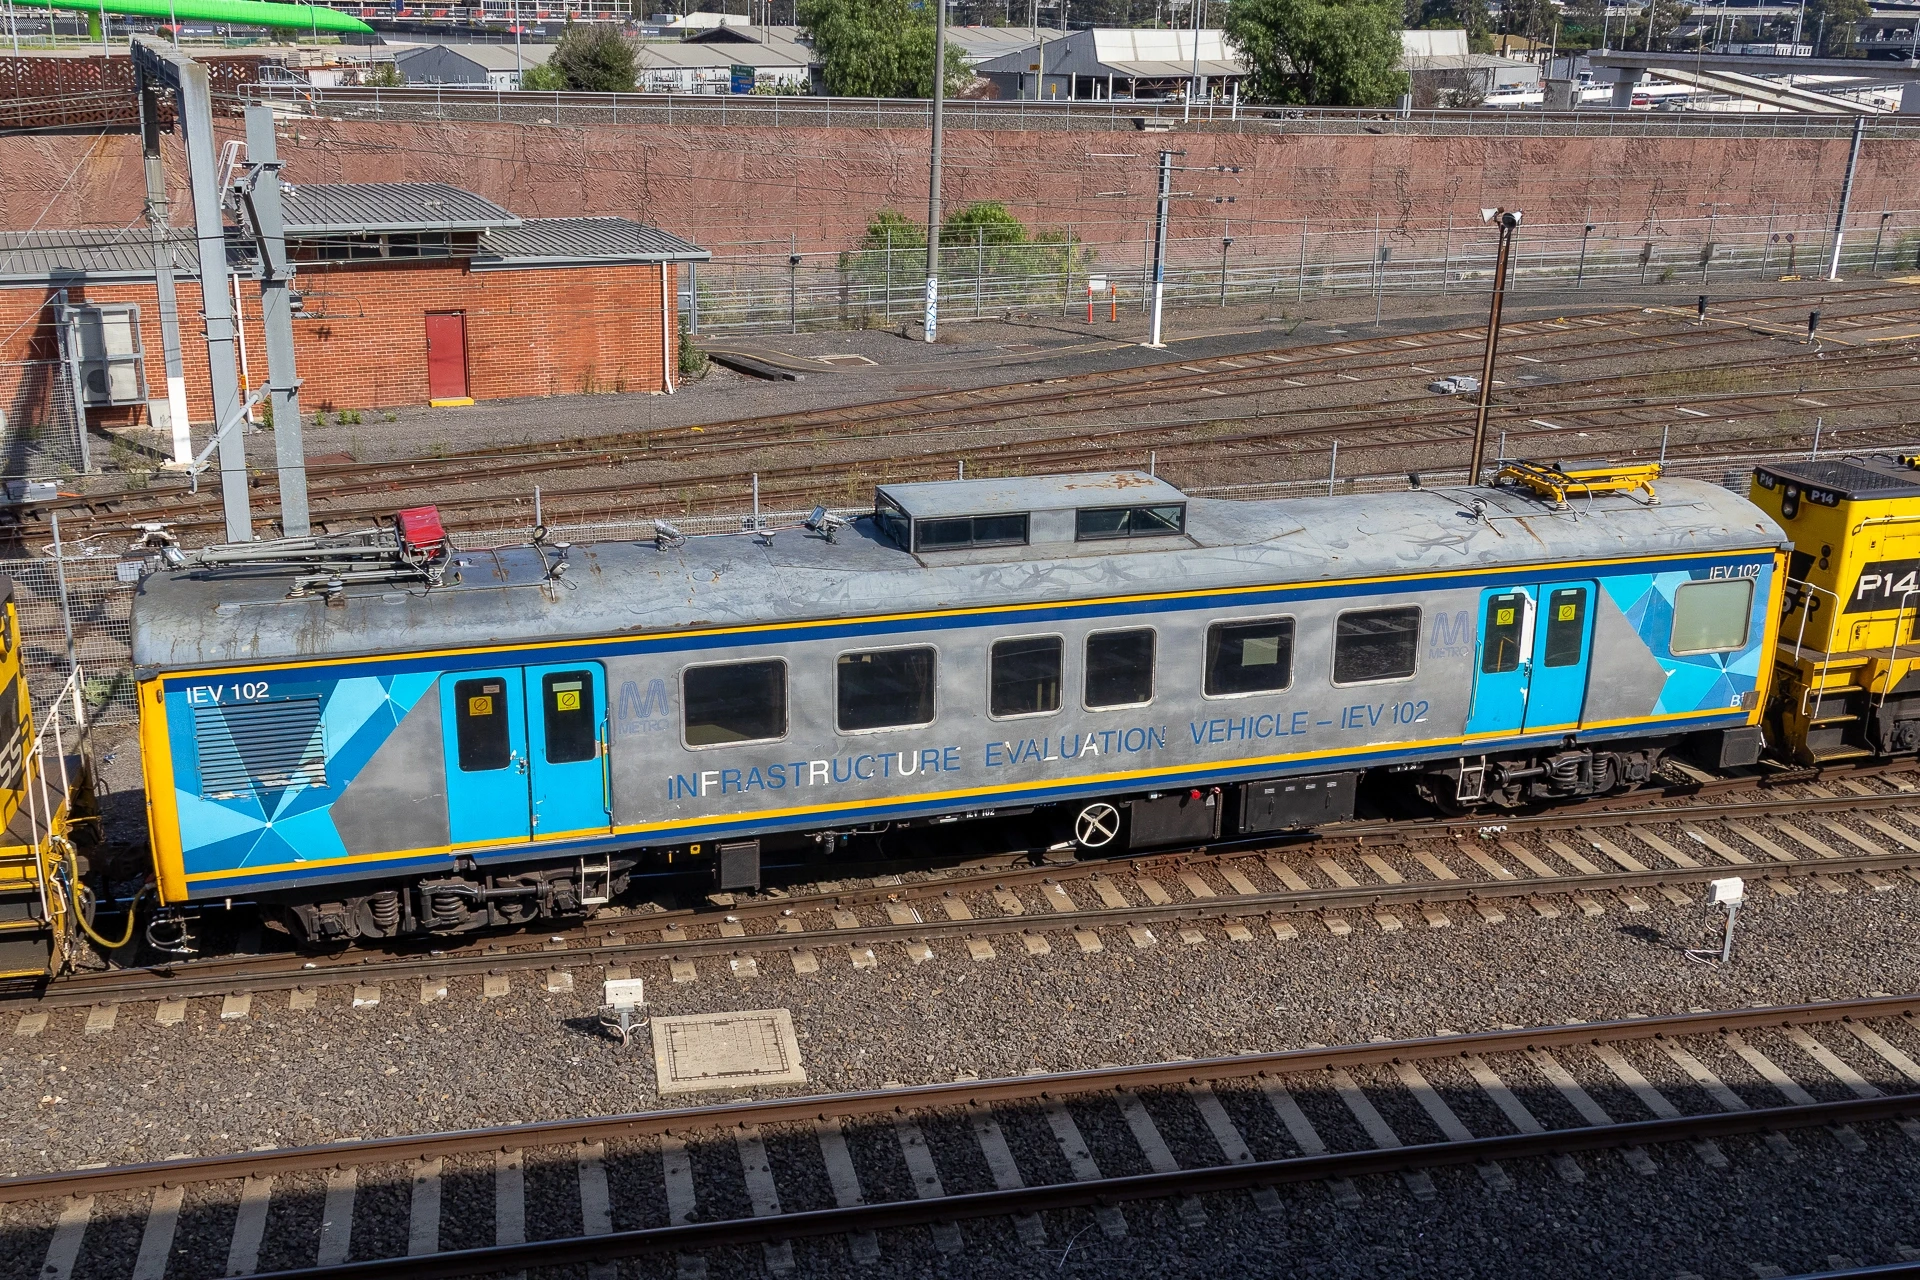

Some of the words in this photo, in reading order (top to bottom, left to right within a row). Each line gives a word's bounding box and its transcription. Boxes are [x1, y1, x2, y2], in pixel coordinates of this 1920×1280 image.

[1759, 472, 1774, 488] P14
[1811, 489, 1834, 505] P14
[1709, 565, 1734, 580] IEV
[1737, 563, 1760, 578] 102
[1857, 570, 1919, 600] P14
[1428, 646, 1469, 660] METRO
[186, 684, 223, 704] IEV
[231, 682, 269, 700] 102
[618, 719, 670, 735] METRO
[668, 746, 961, 800] INFRASTRUCTURE
[985, 725, 1167, 767] EVALUATION
[1189, 711, 1309, 745] VEHICLE
[1340, 703, 1385, 731] IEV
[1391, 700, 1429, 725] 102
